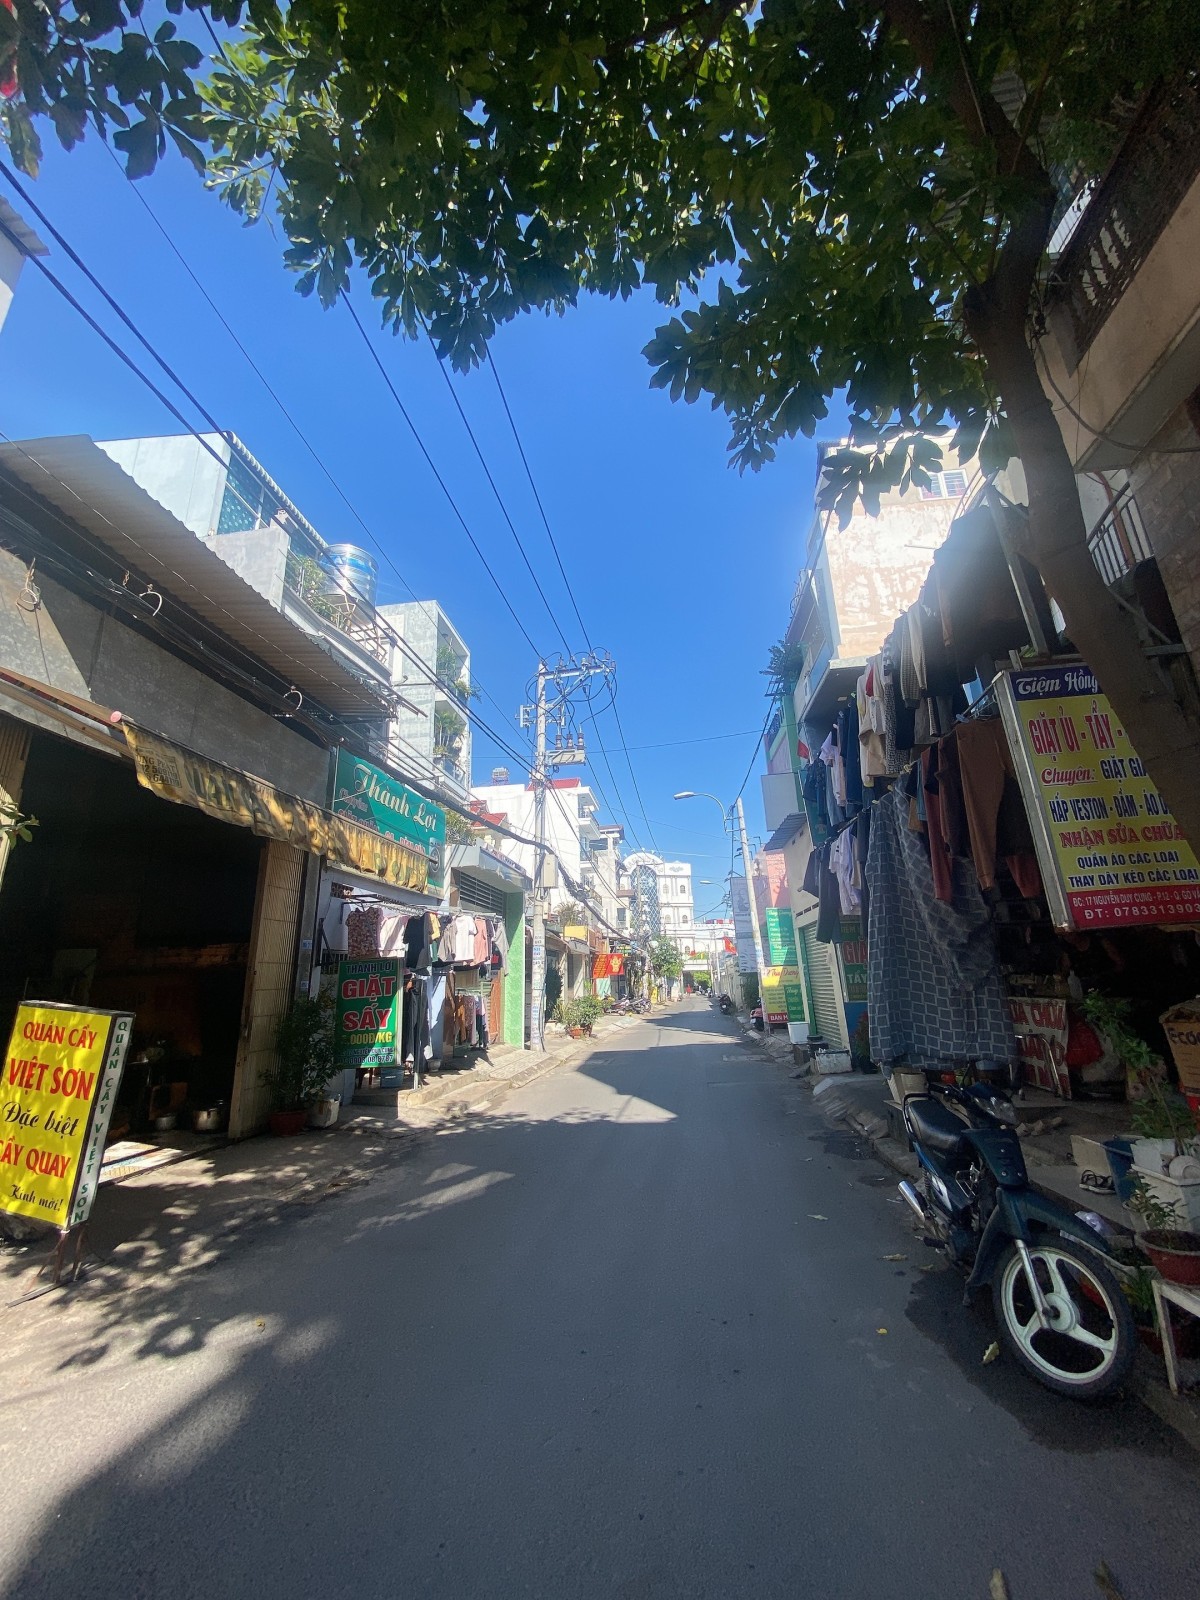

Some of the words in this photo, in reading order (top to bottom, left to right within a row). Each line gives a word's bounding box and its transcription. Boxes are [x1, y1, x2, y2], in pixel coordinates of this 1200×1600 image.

[1016, 676, 1061, 696] Tiệm
[1028, 711, 1063, 762] GIẶT
[1058, 705, 1082, 752] ỦI
[1084, 700, 1116, 750] TẨY
[1041, 766, 1096, 786] Chuyên:
[1099, 754, 1128, 783] GIẶT
[354, 763, 410, 817] Thành
[414, 803, 437, 833] Lợi
[1049, 792, 1069, 823] HẤP
[1070, 795, 1109, 821] VESTON
[1143, 790, 1159, 816] ÁO
[1158, 793, 1171, 815] D
[1059, 826, 1105, 850] NHẬN
[1141, 821, 1188, 842] CHỮA
[1111, 852, 1126, 865] ÁO
[1128, 850, 1151, 864] CÁC
[1154, 850, 1179, 865] LOẠI
[1067, 875, 1096, 888] THAY
[1123, 869, 1144, 884] KÉO
[1148, 868, 1171, 882] CÁC
[1173, 868, 1200, 882] LOẠI
[1072, 897, 1085, 907] ĐC:
[1085, 896, 1092, 905] 17
[1085, 908, 1109, 920] ĐT:
[1114, 903, 1200, 918] 0783313903
[842, 936, 868, 969] GIẶ
[346, 962, 378, 975] THÀNH
[342, 973, 396, 1001] GIẶT
[343, 1003, 393, 1032] SẤY
[23, 1020, 66, 1045] QUÁN
[108, 1020, 128, 1070] QUÁN
[9, 1055, 50, 1096] VIỆT
[50, 1066, 96, 1101] SƠN
[2, 1101, 40, 1130] Đặc
[44, 1110, 80, 1139] biệt
[25, 1147, 72, 1179] QUAY
